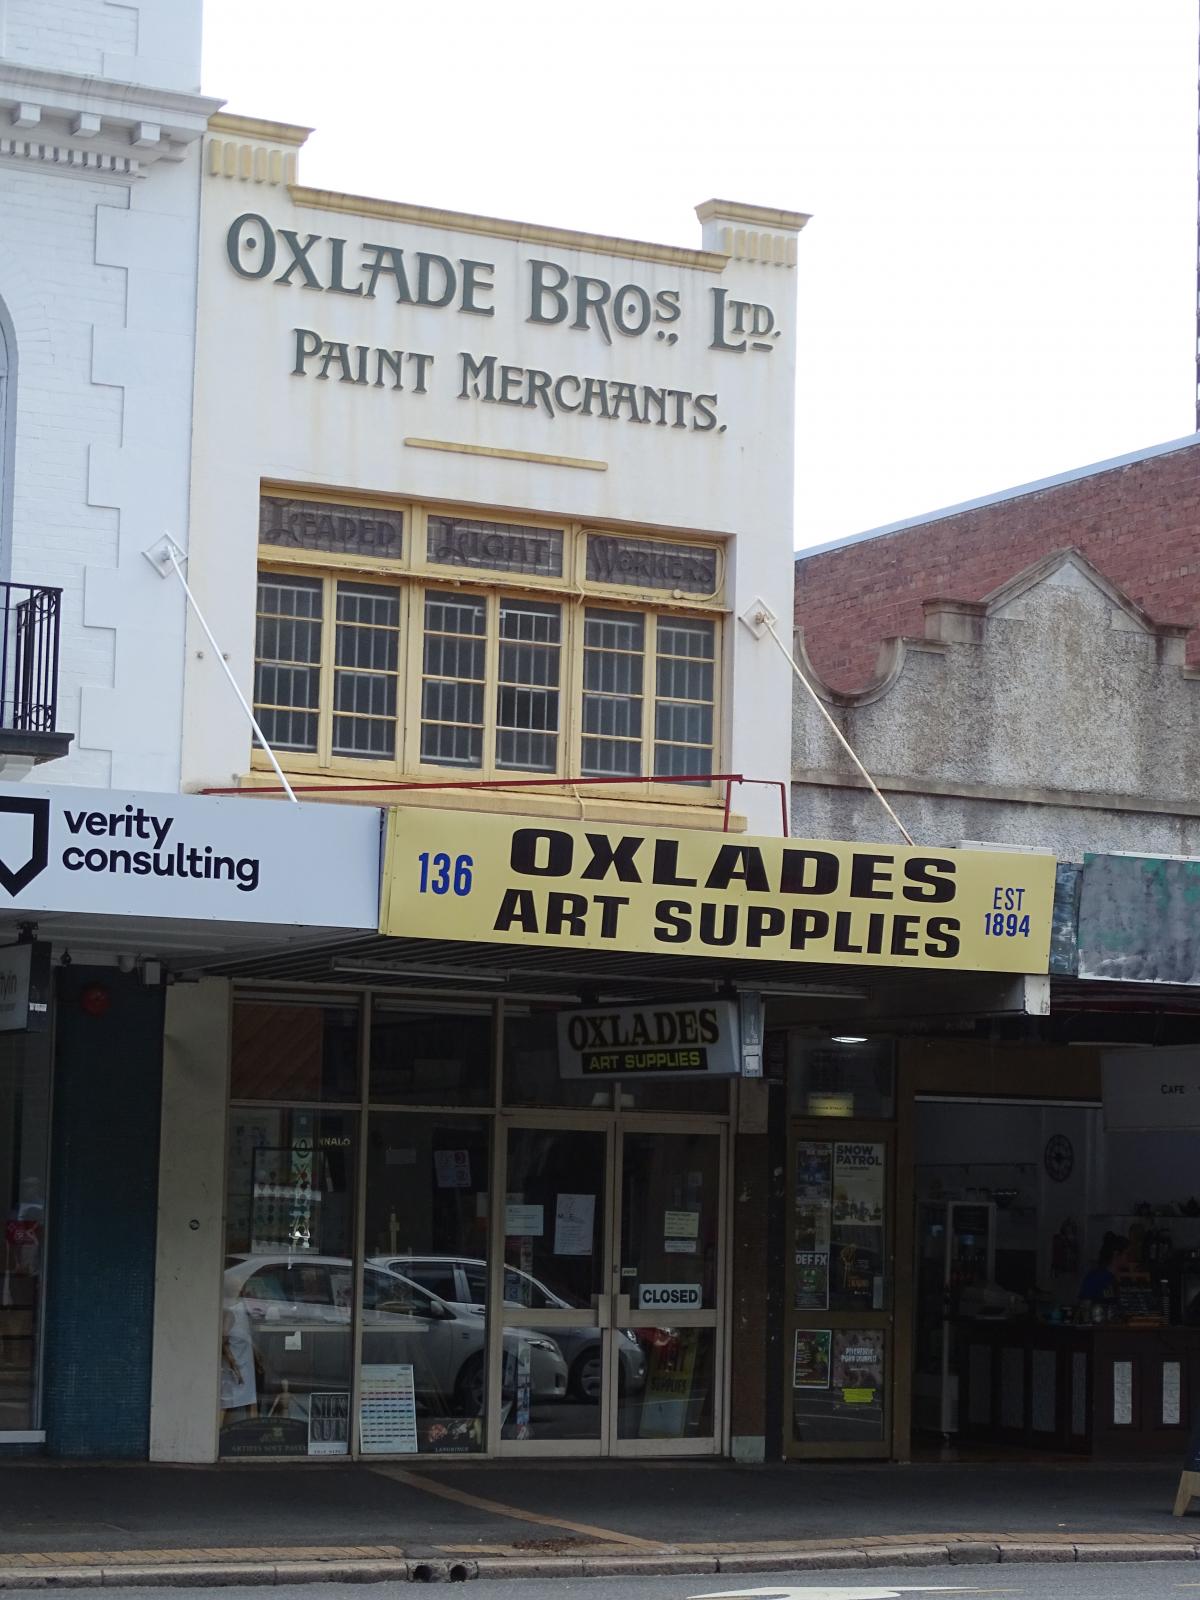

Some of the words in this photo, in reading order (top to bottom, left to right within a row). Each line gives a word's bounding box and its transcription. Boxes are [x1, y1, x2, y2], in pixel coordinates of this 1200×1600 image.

[227, 213, 495, 316] OXLADE
[292, 328, 435, 393] PAINT
[457, 352, 727, 433] MERCHANTS.
[63, 804, 174, 849] verity
[62, 842, 260, 892] consulting
[418, 852, 474, 896] 136
[510, 828, 957, 903] OXLADES
[993, 887, 1026, 913] EST
[493, 889, 628, 938] ART
[653, 900, 960, 959] SUPPLIES
[984, 912, 1031, 938] 1894
[568, 1008, 720, 1051] OXLADES
[589, 1055, 620, 1071] ART
[625, 1051, 702, 1069] SUPPLIES
[836, 1145, 874, 1155] SNOW
[836, 1155, 883, 1166] PATROL
[795, 1254, 813, 1265] DEF
[642, 1289, 699, 1304] CLOSED
